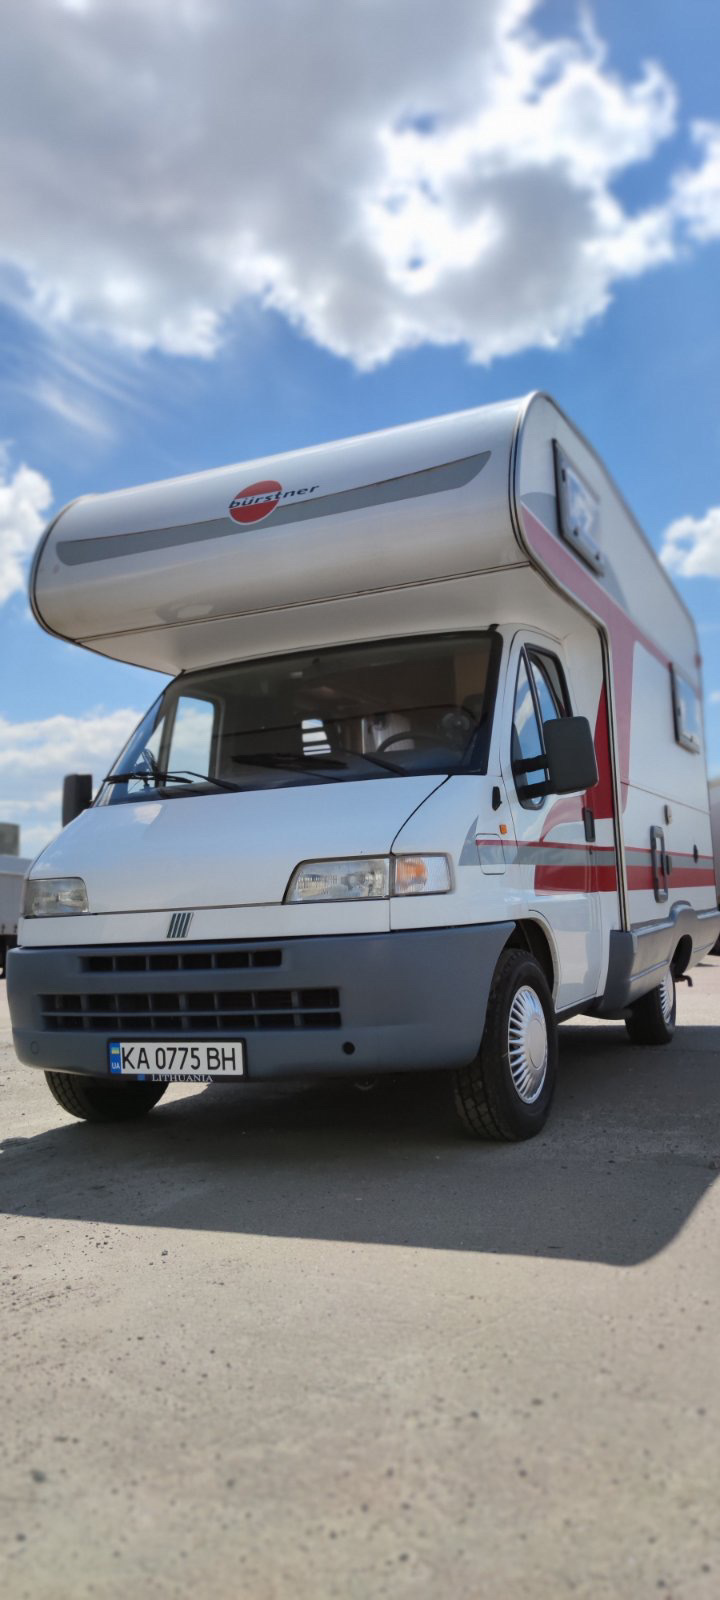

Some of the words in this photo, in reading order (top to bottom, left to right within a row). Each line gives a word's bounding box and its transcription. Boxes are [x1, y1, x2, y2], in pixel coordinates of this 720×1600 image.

[228, 485, 320, 509] bürstner
[111, 1062, 120, 1070] UA
[121, 1047, 150, 1070] KA
[155, 1047, 201, 1070] 0775
[206, 1047, 236, 1071] BH
[151, 1074, 213, 1082] LITHUANIA
